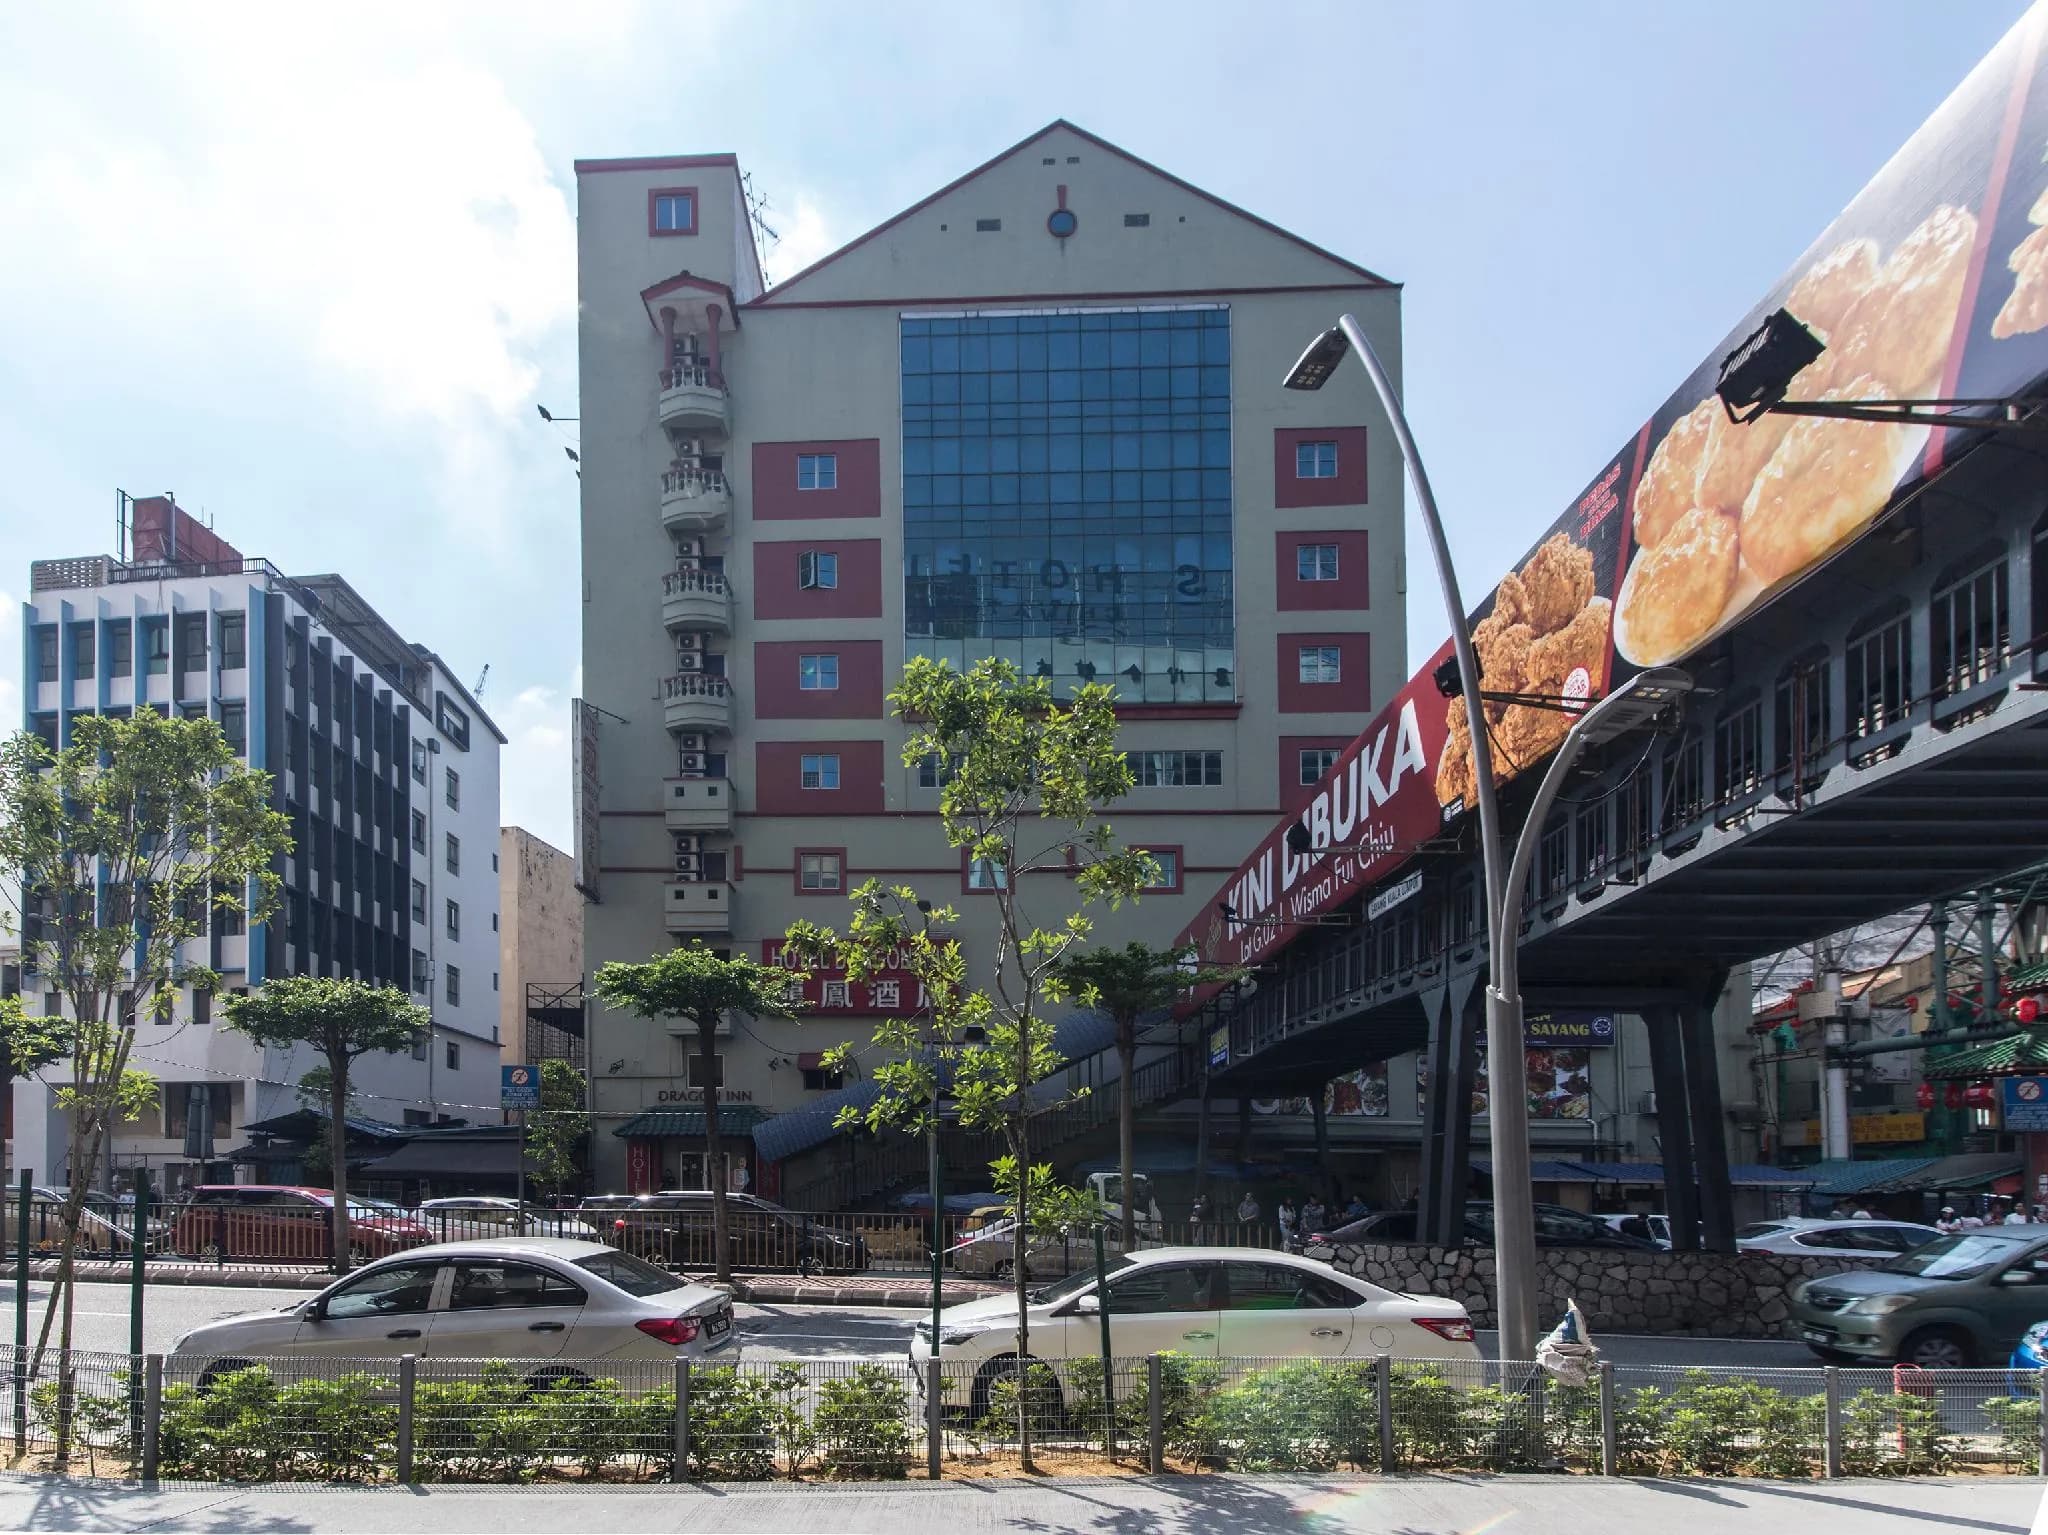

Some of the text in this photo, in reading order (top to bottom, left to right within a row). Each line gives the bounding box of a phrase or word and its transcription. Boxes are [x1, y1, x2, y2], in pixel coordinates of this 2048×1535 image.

[1228, 847, 1274, 942] KINI
[1291, 876, 1332, 924] Wisma
[1530, 1023, 1590, 1036] SAYANG
[657, 1090, 752, 1103] DRAG INN
